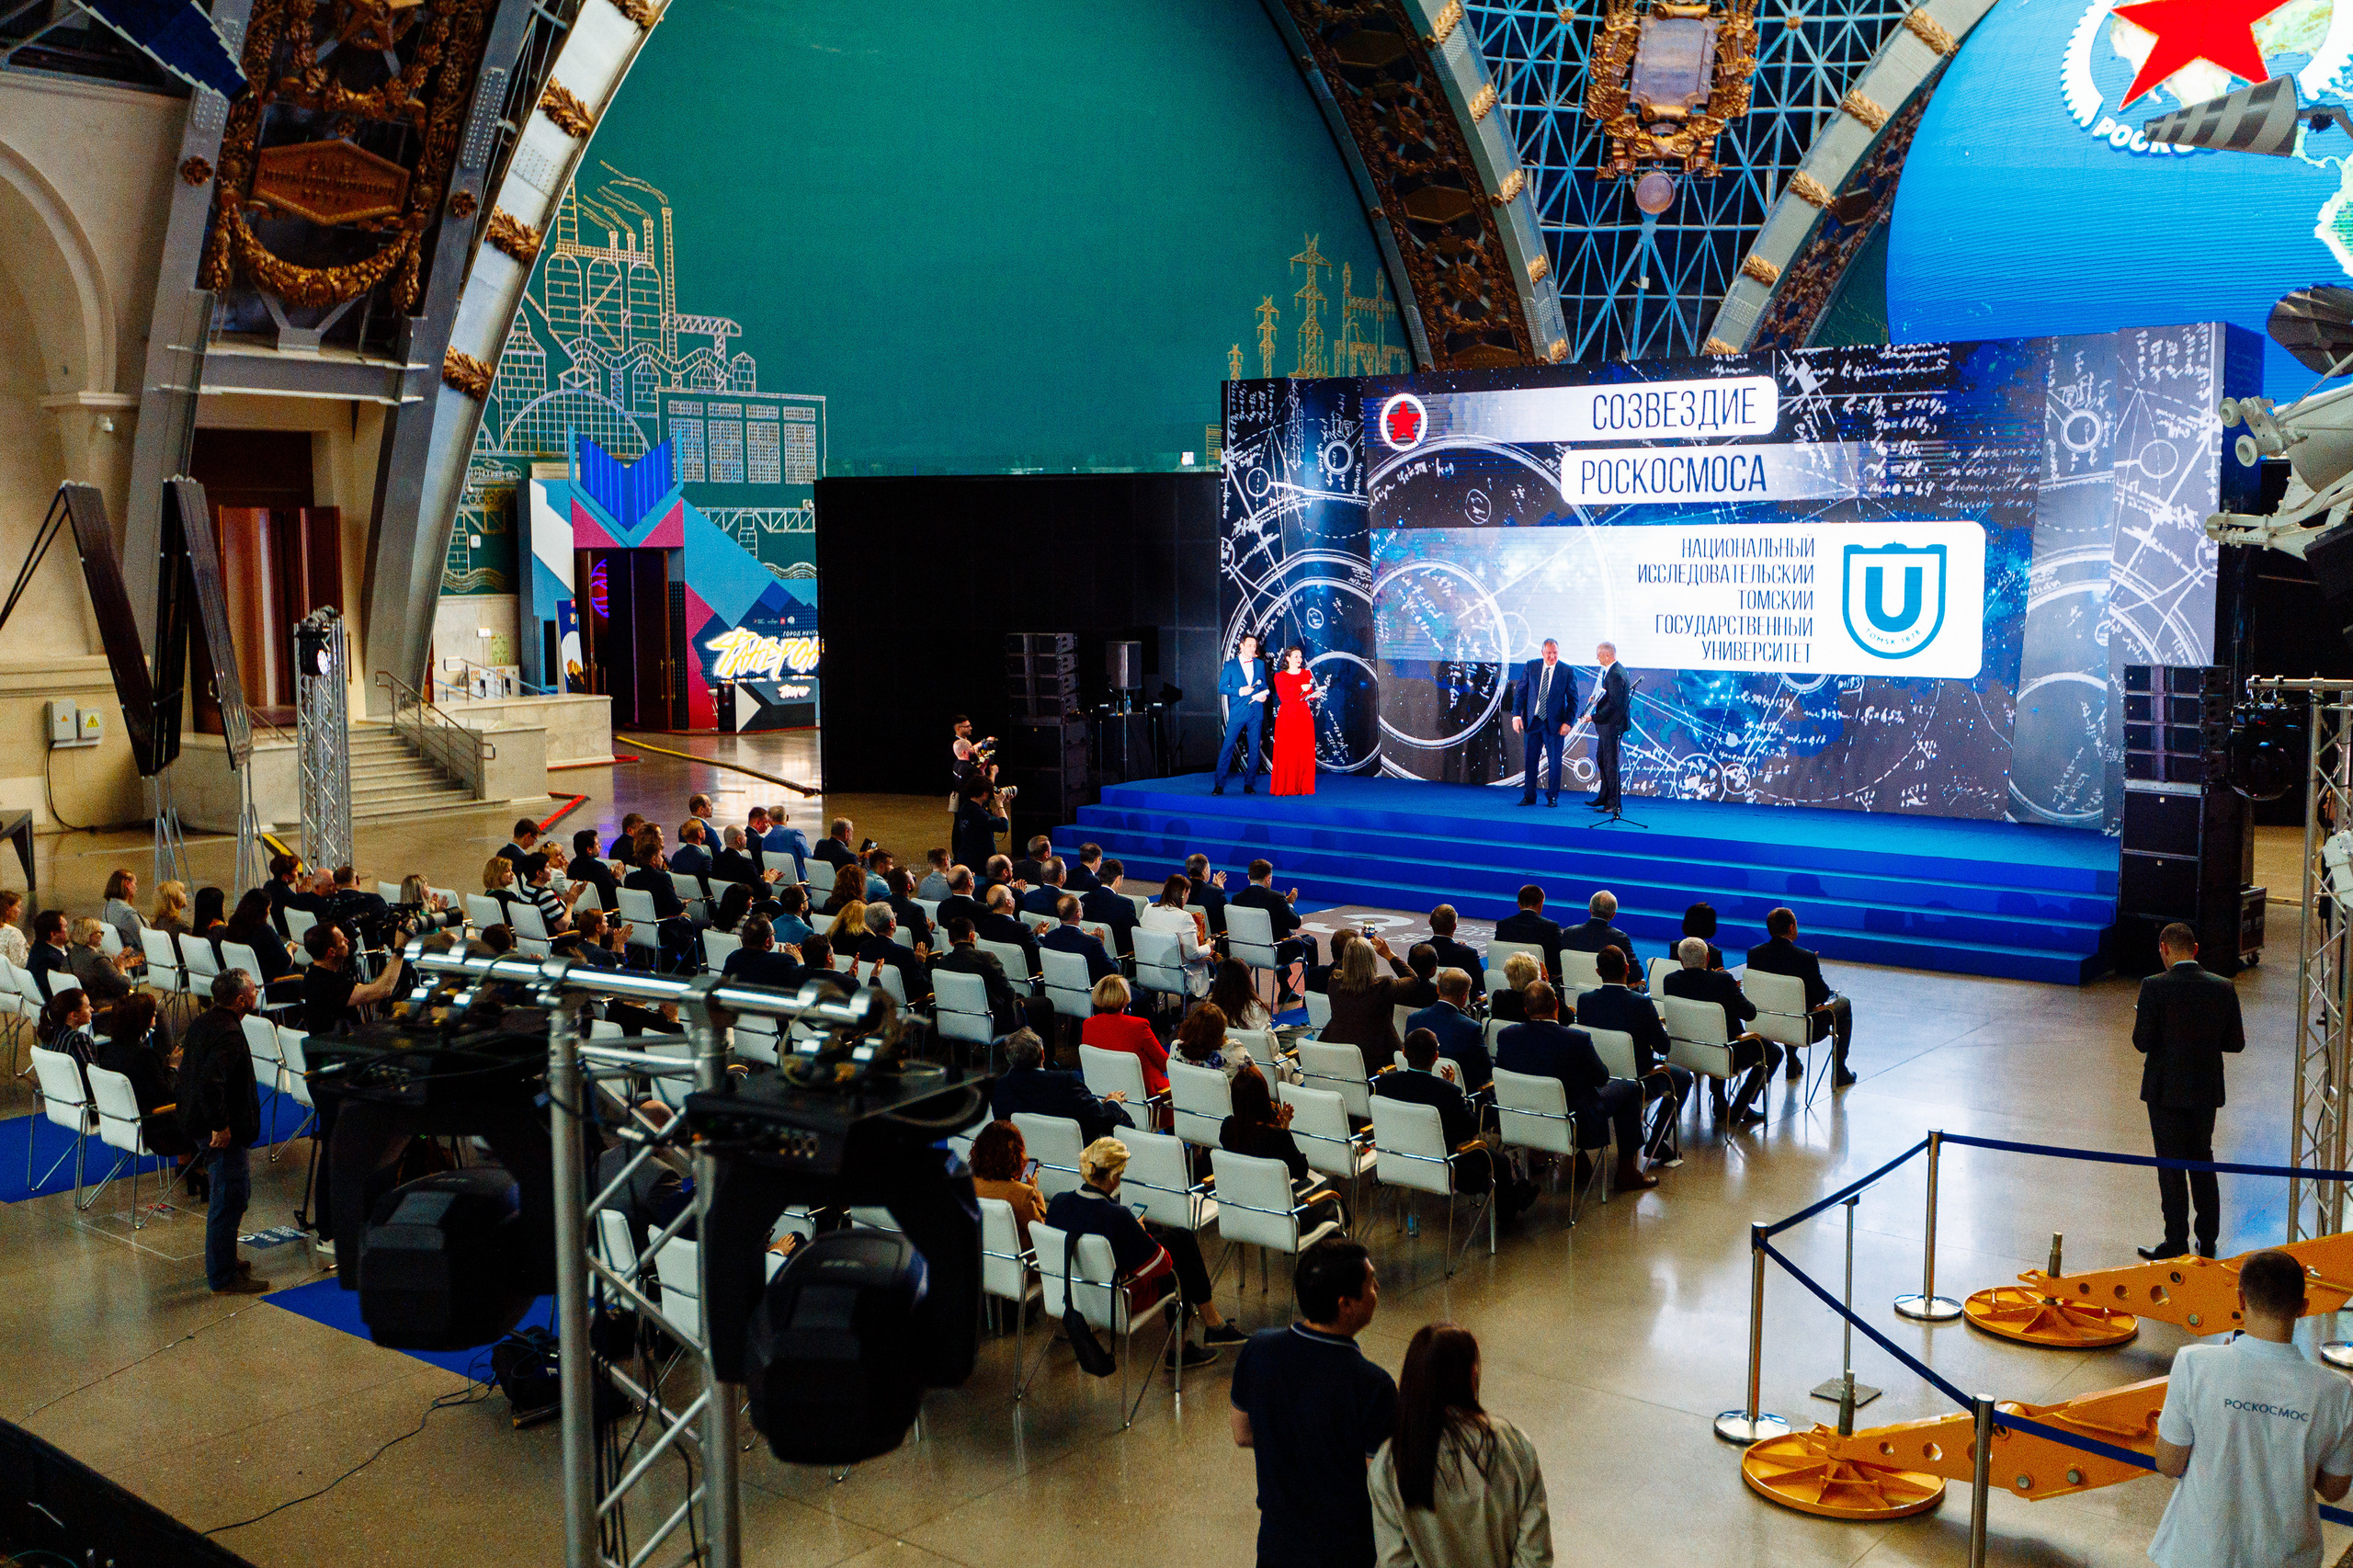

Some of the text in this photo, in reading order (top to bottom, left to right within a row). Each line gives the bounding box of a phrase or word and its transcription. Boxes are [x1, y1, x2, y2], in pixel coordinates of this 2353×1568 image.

[1592, 387, 1756, 430] СОЗВЕЗДИЕ
[1582, 454, 1767, 494] РОСКОСМОСА
[1681, 533, 1814, 560] НАЦИОНАЛЬНЫЙ
[1638, 560, 1813, 585] ИССЛЕДОВАТЕЛЬСКИЙ
[1737, 586, 1813, 610] ТОМСКИЙ
[1865, 566, 1923, 633] U
[1655, 613, 1813, 637] ГОСУДАРСТВЕННЫЙ
[1865, 628, 1896, 645] TOMSK
[1701, 641, 1813, 663] УНИВЕРСИТЕТ
[2224, 1399, 2310, 1422] РОСКОСМОС
